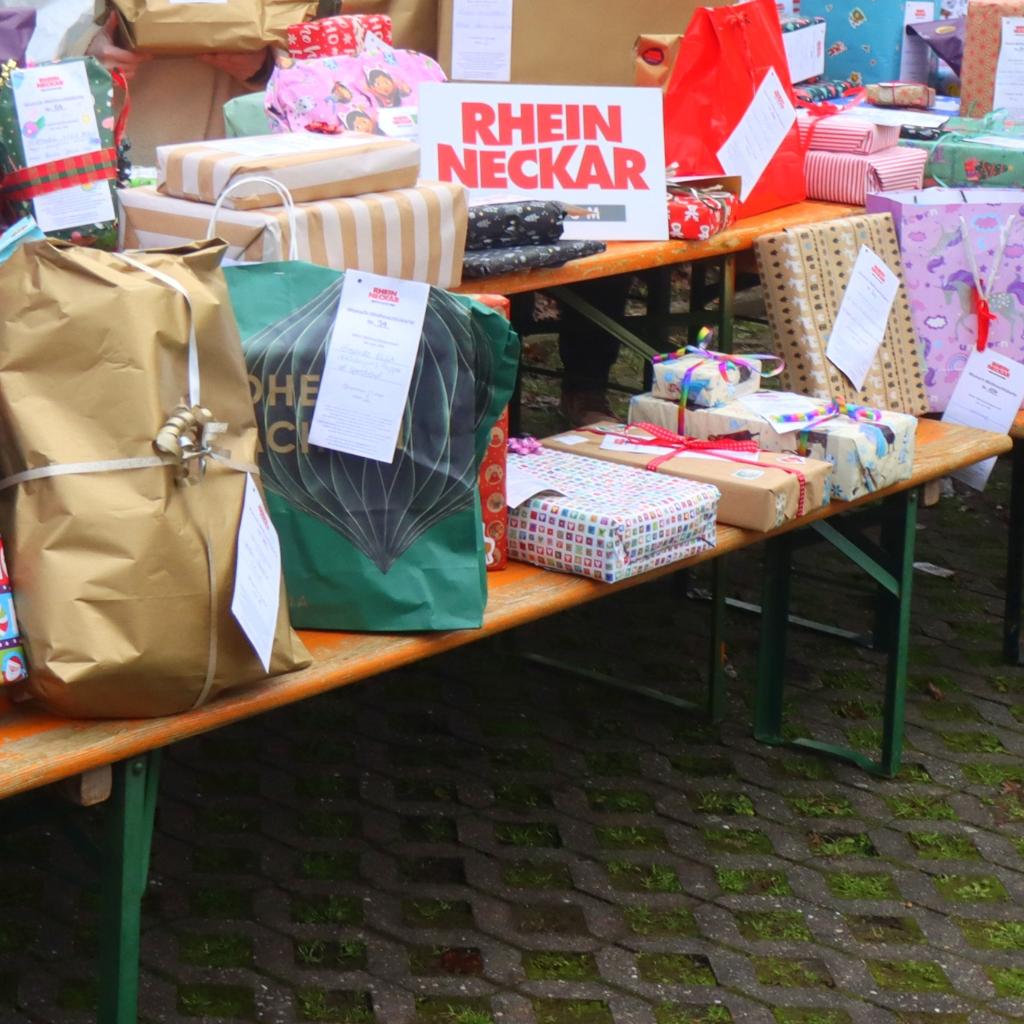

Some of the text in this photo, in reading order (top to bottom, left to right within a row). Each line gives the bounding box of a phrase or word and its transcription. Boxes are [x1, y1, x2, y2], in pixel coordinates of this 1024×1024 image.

[462, 102, 622, 146] RHEIN
[437, 143, 650, 190] NECKAR
[368, 291, 399, 303] NECKAR
[372, 287, 397, 297] RHEIN
